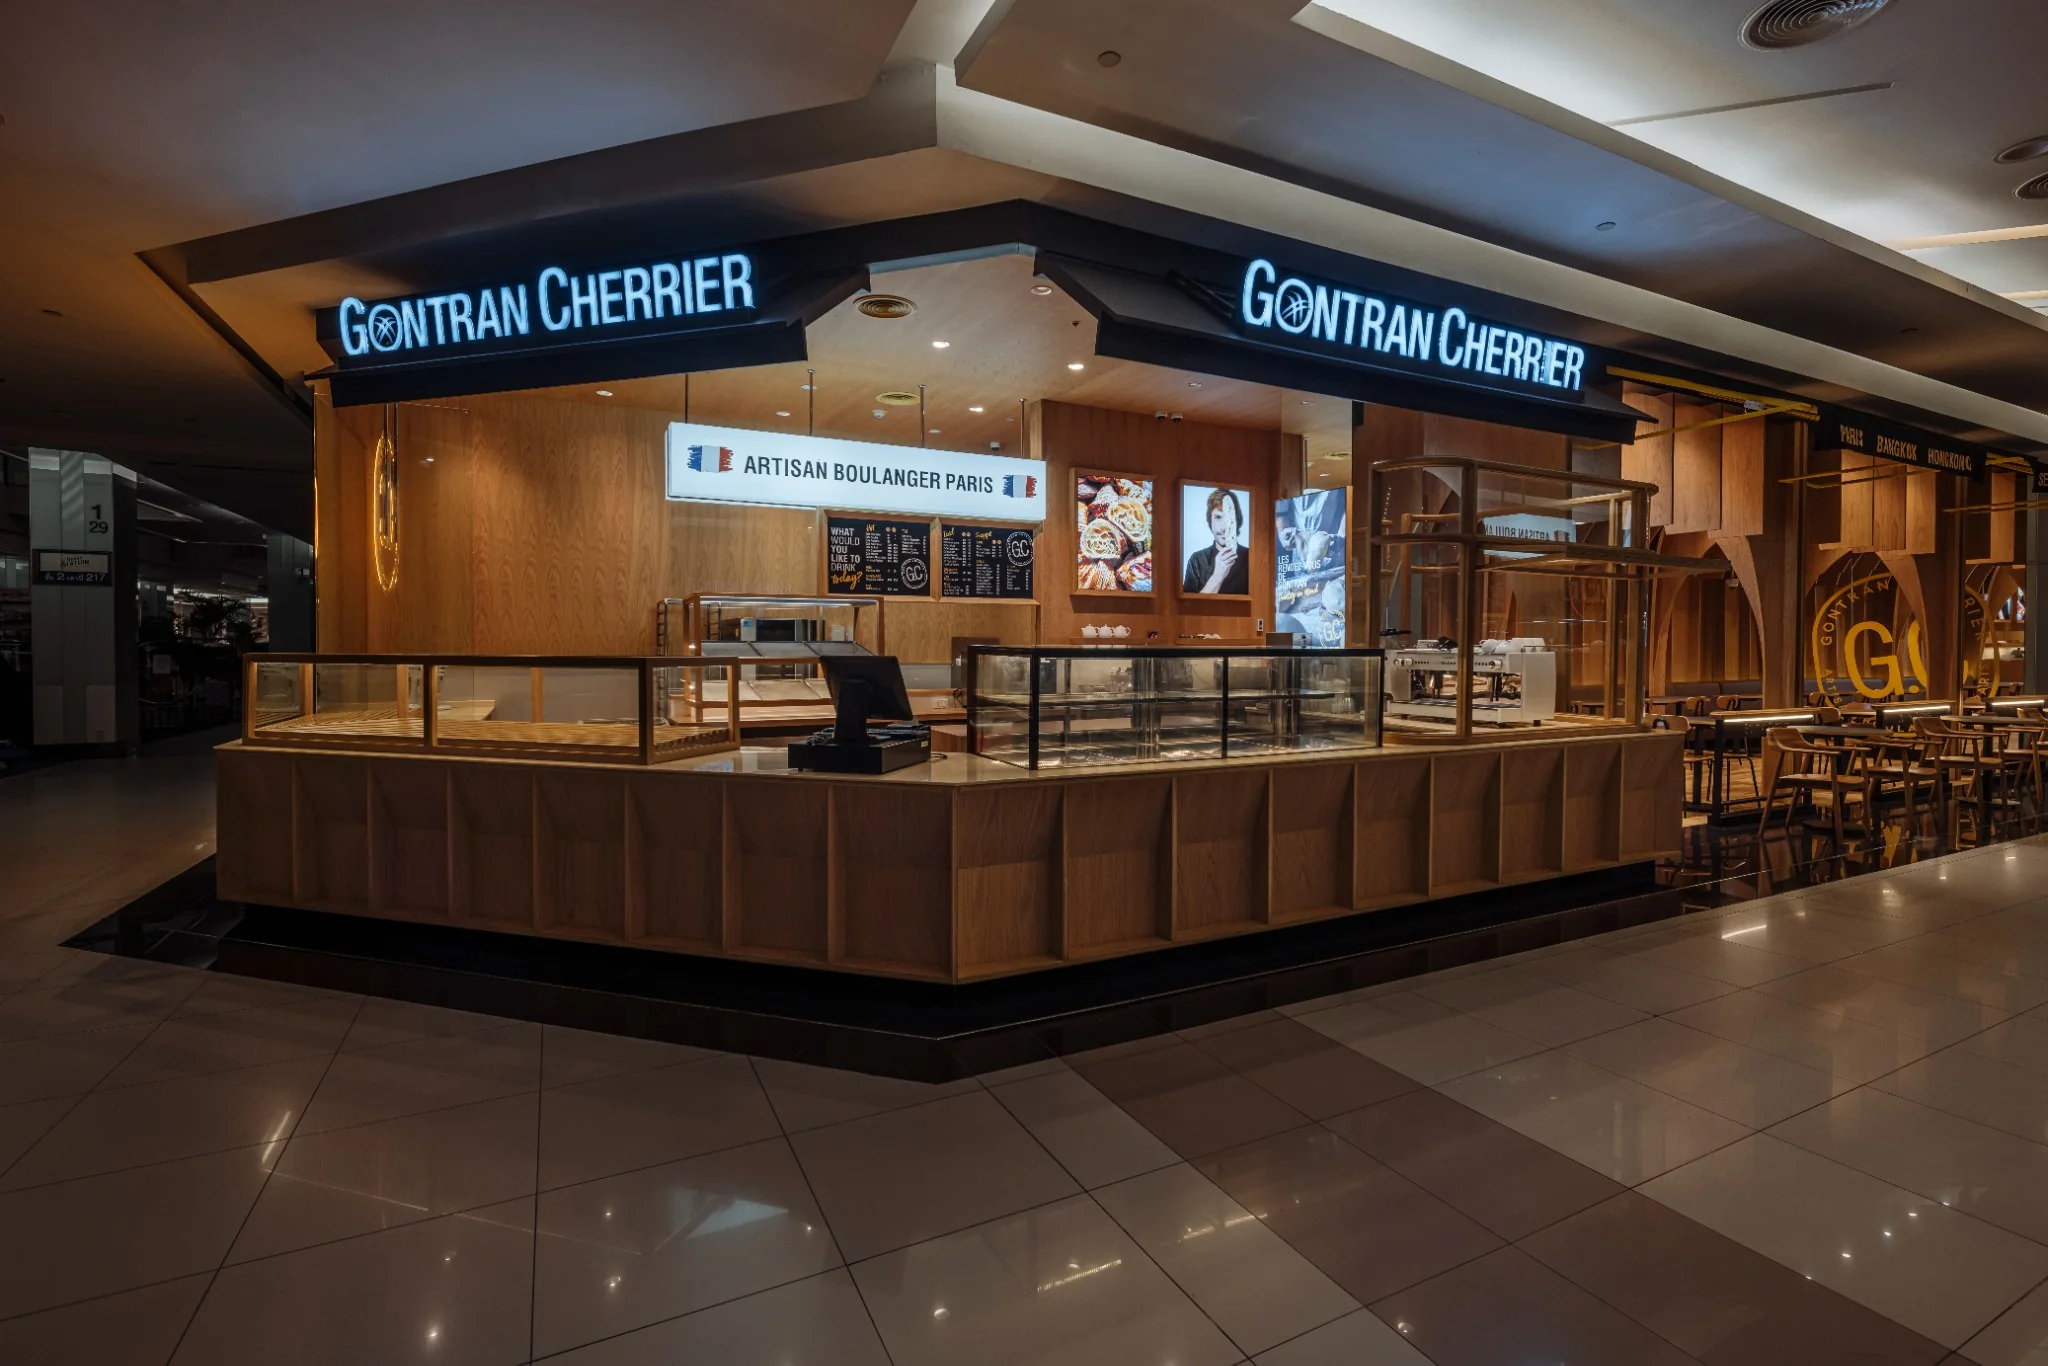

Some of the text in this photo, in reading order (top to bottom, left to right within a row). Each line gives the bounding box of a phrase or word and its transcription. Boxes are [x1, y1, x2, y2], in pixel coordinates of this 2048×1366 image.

[339, 253, 754, 355] GONTRAN CHERRIER
[1242, 258, 1585, 391] GONTRAN CHERRIER
[743, 455, 994, 494] ARTISAN BOULANGER PARIS
[92, 504, 101, 519] 1
[89, 520, 108, 534] 29
[830, 527, 855, 536] WHAT
[830, 536, 860, 546] WOULD
[831, 545, 848, 554] YOU
[830, 553, 860, 563] LIKE TO
[830, 563, 856, 572] DRINK
[86, 573, 106, 582] 217
[830, 569, 863, 590] today?
[1820, 580, 1890, 646] GONTRAN
